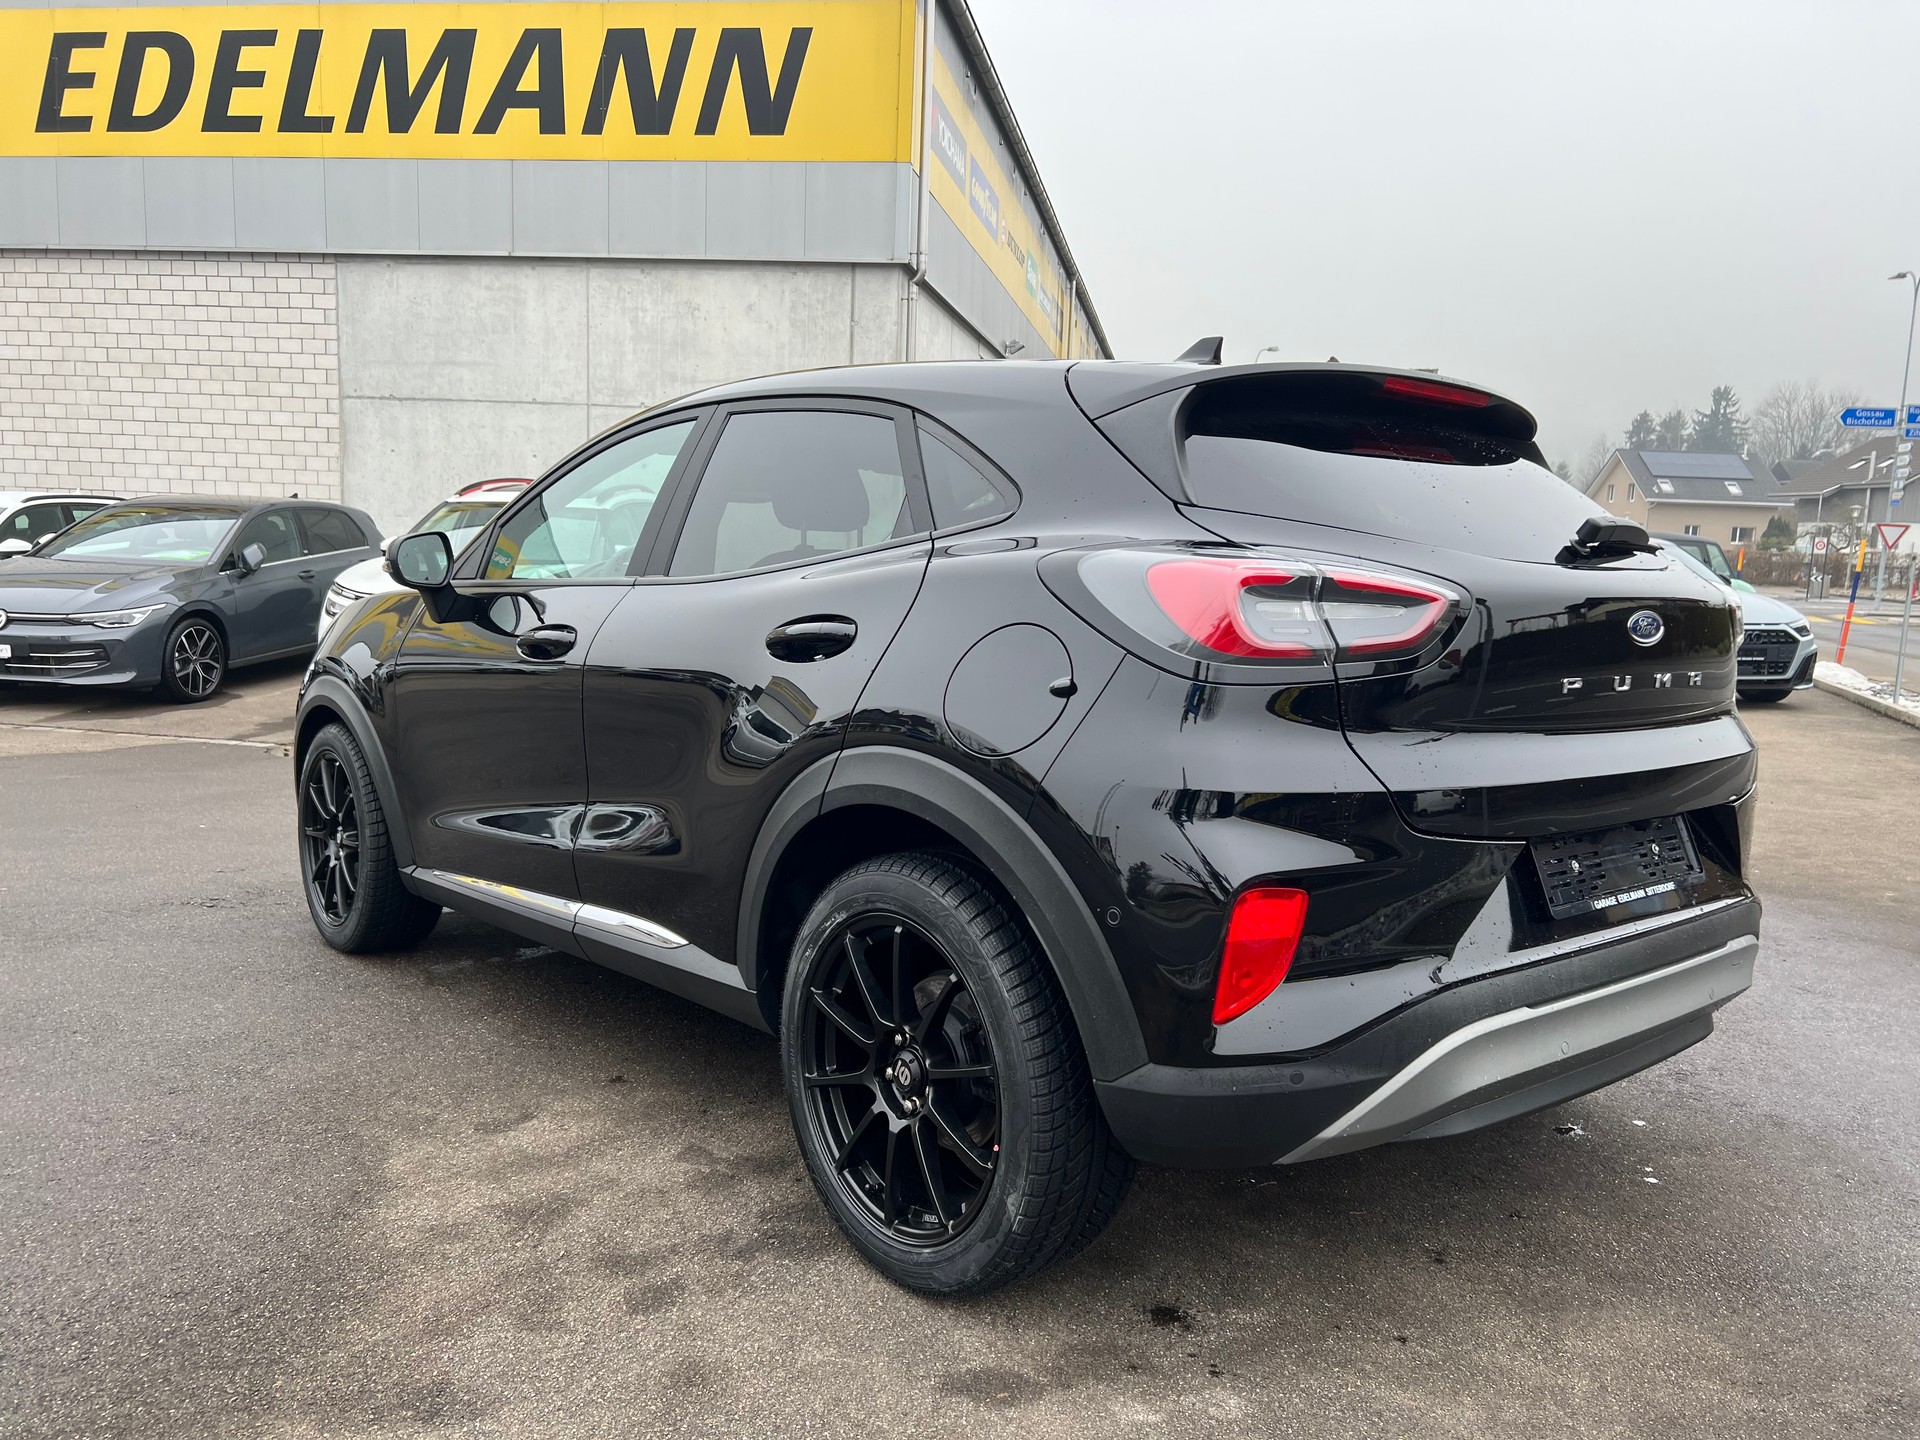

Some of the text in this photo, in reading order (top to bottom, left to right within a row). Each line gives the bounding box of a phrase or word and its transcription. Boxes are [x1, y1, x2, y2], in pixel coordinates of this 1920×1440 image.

[35, 27, 813, 136] EDELMANN
[938, 115, 965, 179] YOKOHAMA
[1006, 230, 1026, 269] DUNLOP
[1846, 416, 1892, 426] Bischofszell
[1856, 409, 1885, 418] Gossau
[1635, 616, 1657, 636] Ford
[1561, 671, 1702, 694] PUMA
[1594, 881, 1675, 909] GARAGE EDELMANN SITTERDORF
